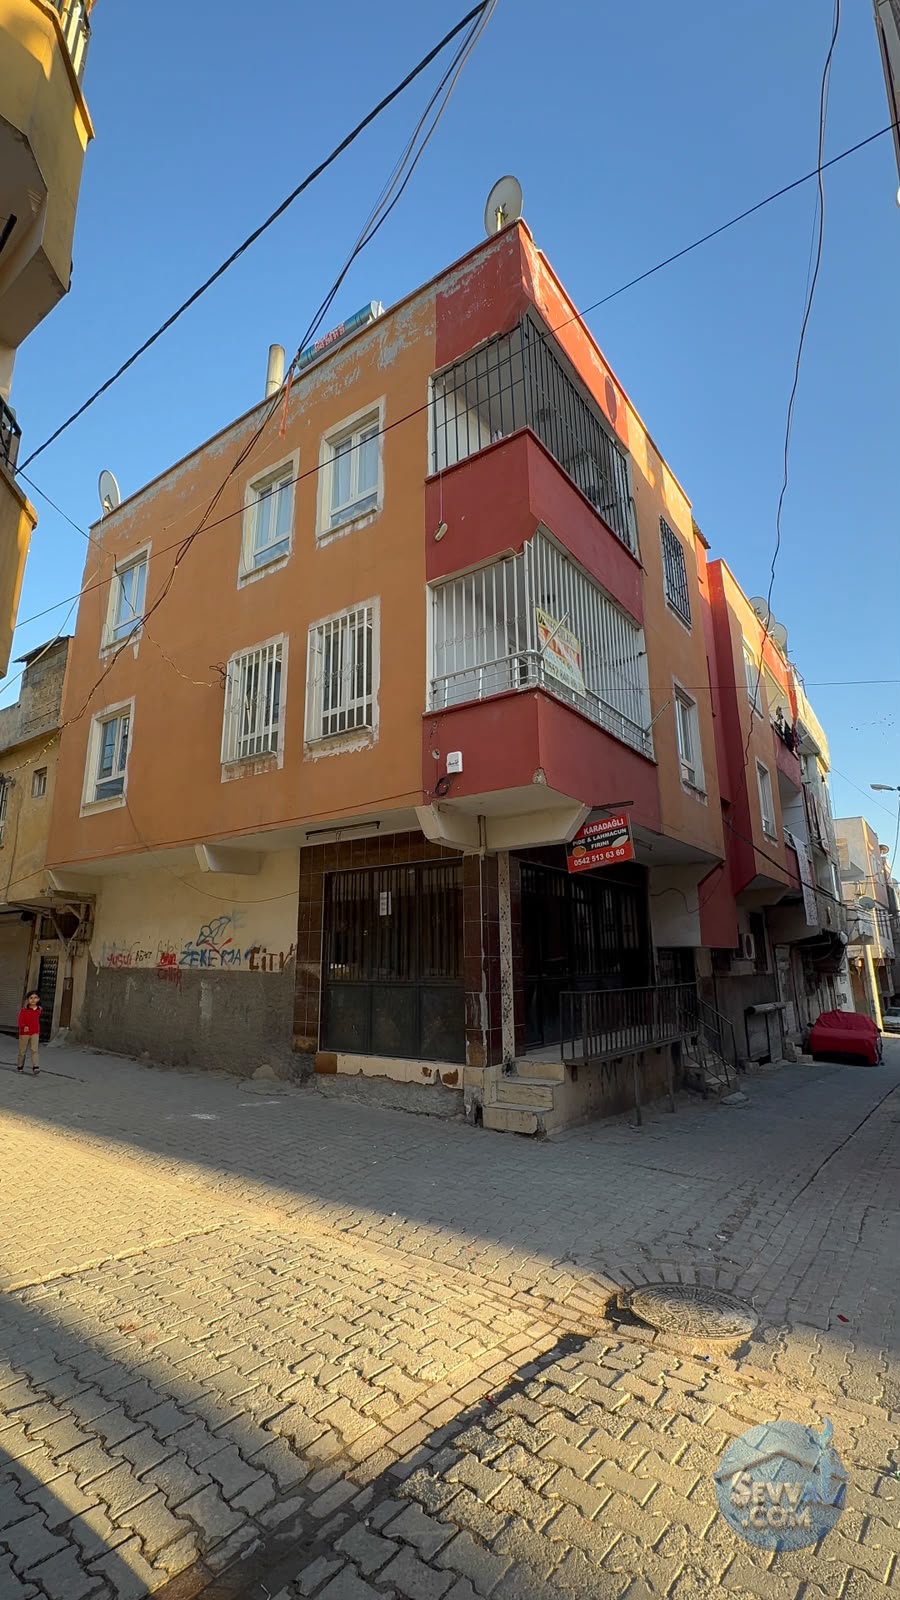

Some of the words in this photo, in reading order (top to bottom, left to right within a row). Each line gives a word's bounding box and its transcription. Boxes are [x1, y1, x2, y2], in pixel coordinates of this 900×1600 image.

[583, 818, 624, 835] KARADAĞLI
[574, 857, 590, 866] 0542
[592, 853, 604, 861] 513
